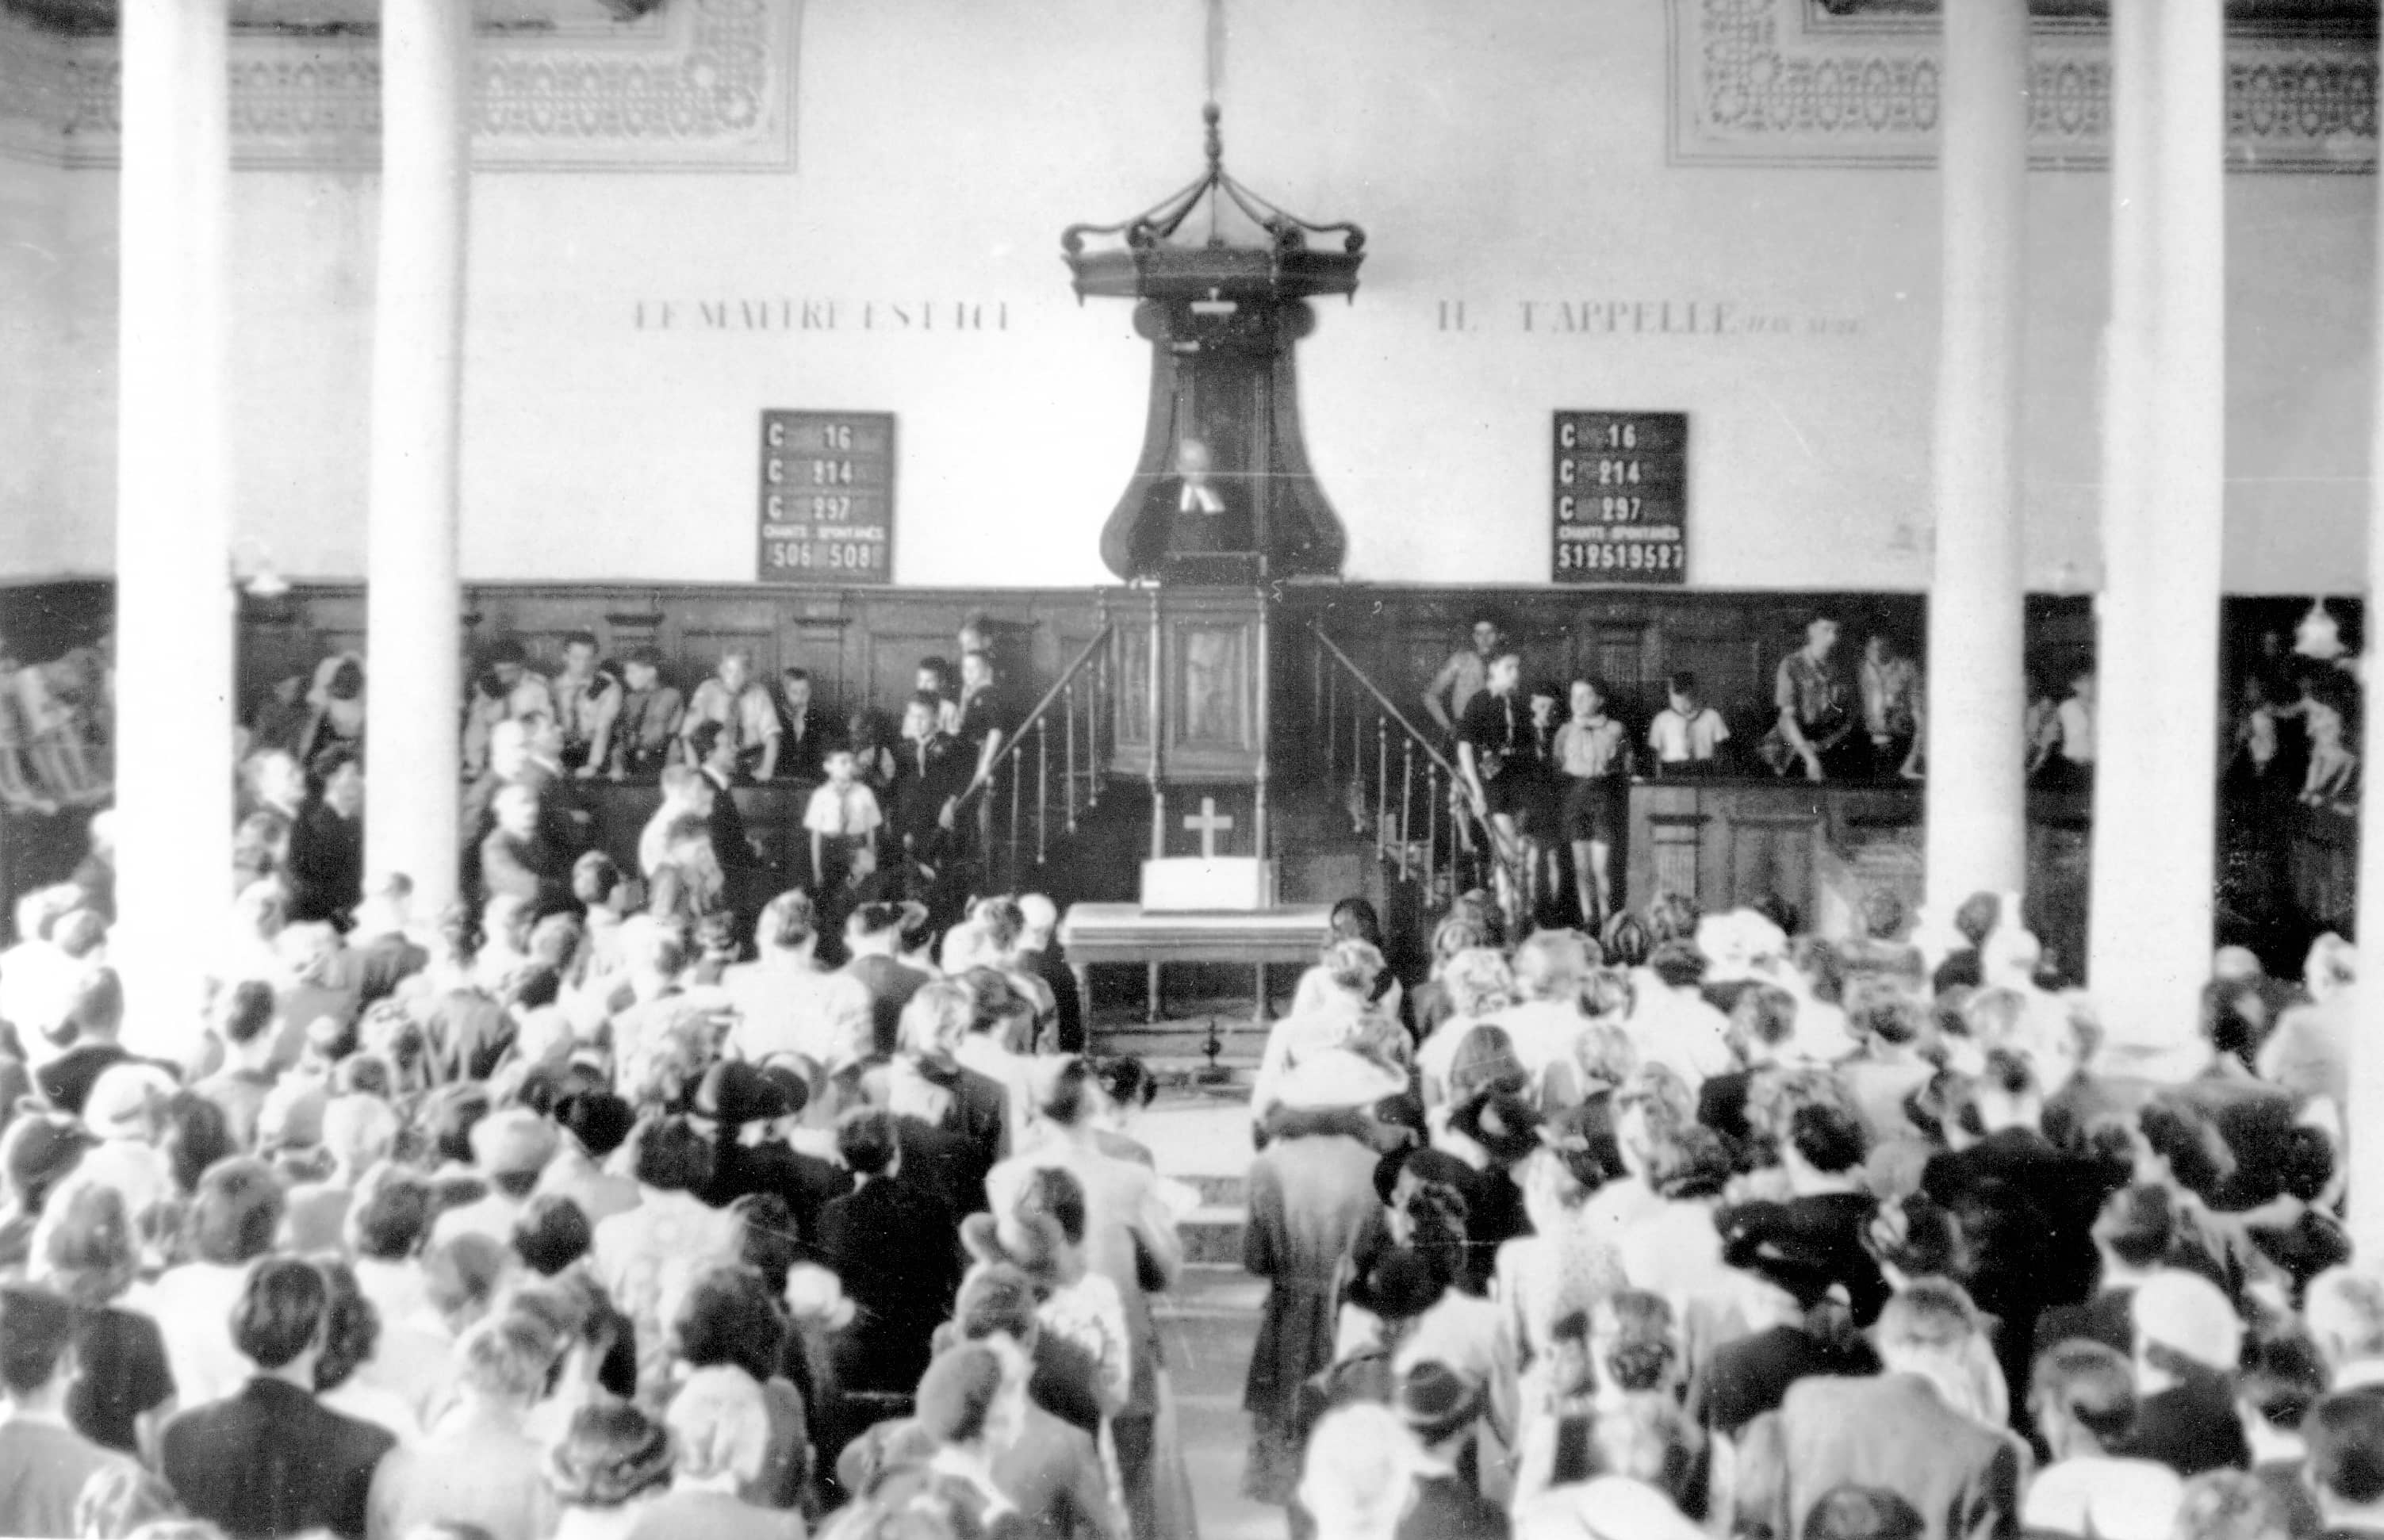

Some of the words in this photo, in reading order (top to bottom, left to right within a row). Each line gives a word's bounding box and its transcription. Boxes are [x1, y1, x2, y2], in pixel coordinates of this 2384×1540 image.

[634, 301, 673, 330] LE
[863, 301, 937, 330] EST
[955, 301, 1010, 330] ICI
[768, 422, 784, 447] C
[825, 424, 851, 450] 16
[1561, 423, 1575, 448] C
[1608, 423, 1636, 448] 16
[768, 458, 784, 484] C
[814, 459, 853, 485] 214
[1560, 458, 1574, 484] C
[1599, 459, 1641, 484] 214
[768, 495, 783, 520] C
[814, 496, 851, 521] 297
[1560, 496, 1574, 520] C
[1602, 496, 1642, 521] 297
[773, 542, 811, 567] 506
[830, 543, 871, 568] 508
